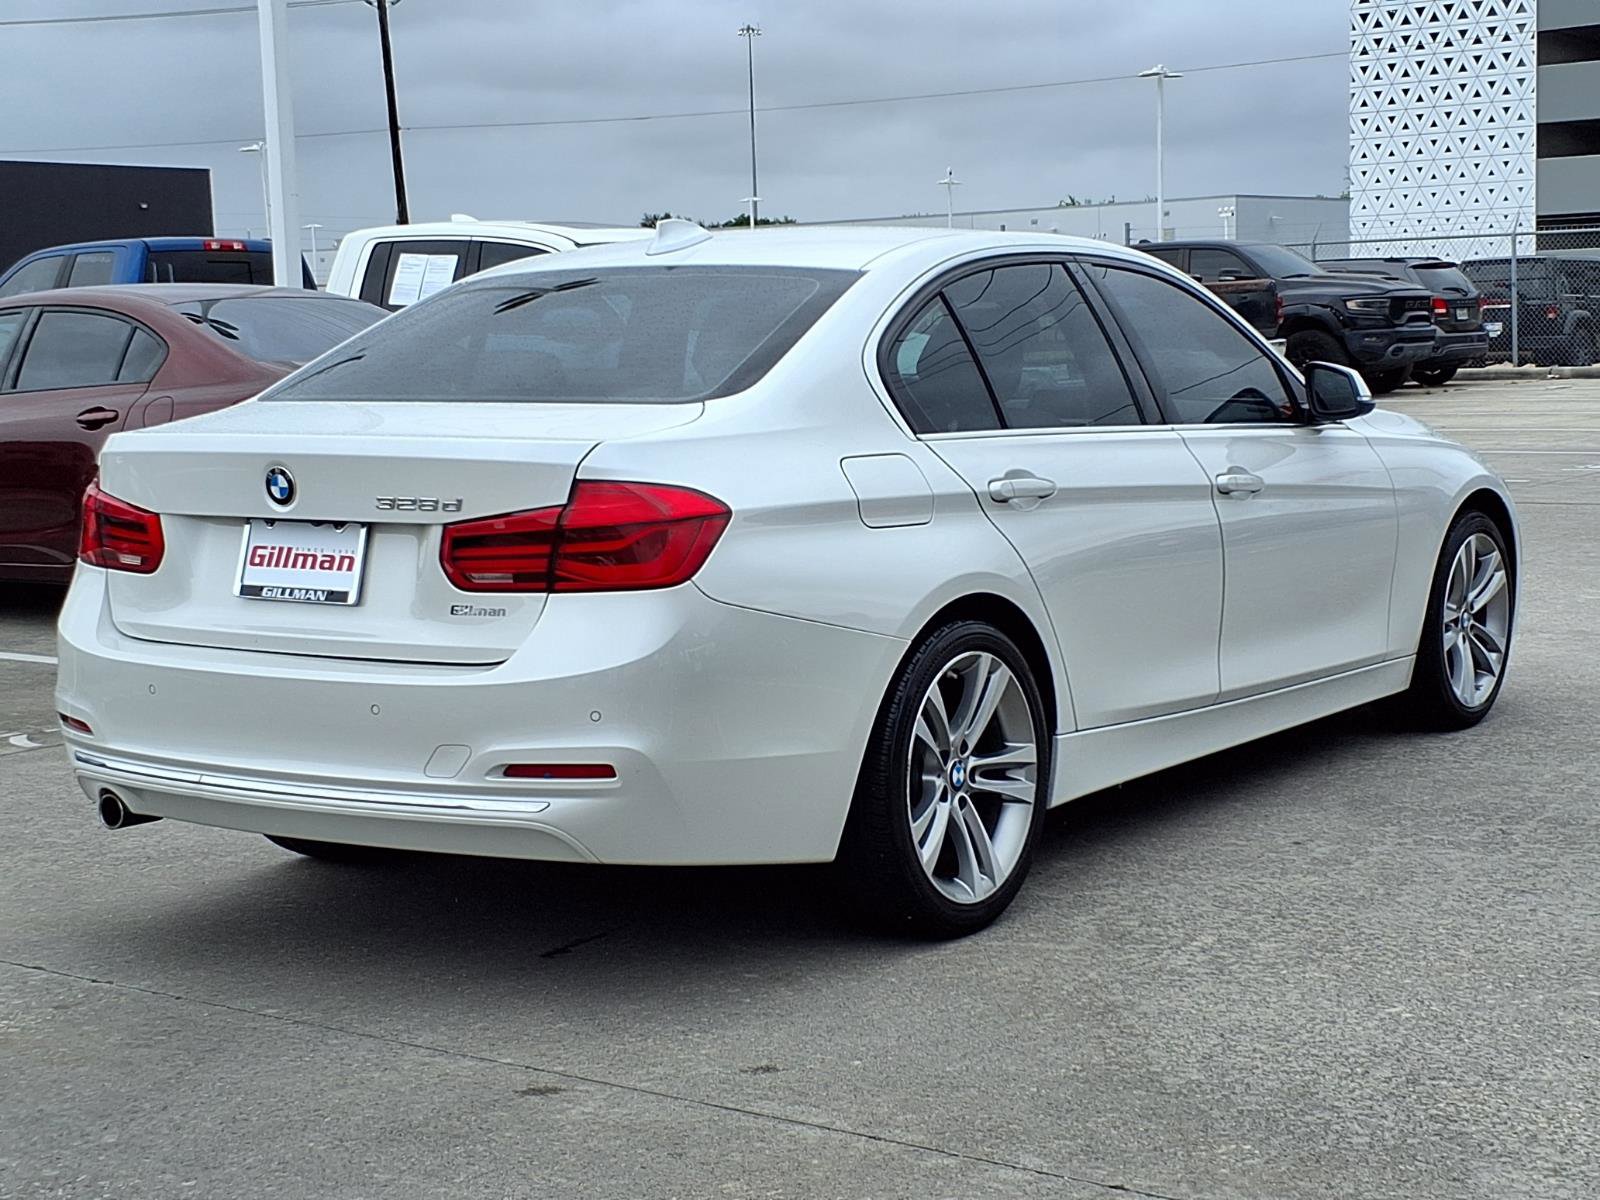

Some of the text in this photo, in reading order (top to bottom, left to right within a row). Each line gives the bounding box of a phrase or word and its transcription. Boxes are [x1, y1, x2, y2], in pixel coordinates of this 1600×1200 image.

[375, 496, 464, 512] 328d
[248, 545, 356, 572] Gillman
[261, 587, 328, 601] GILLMAN
